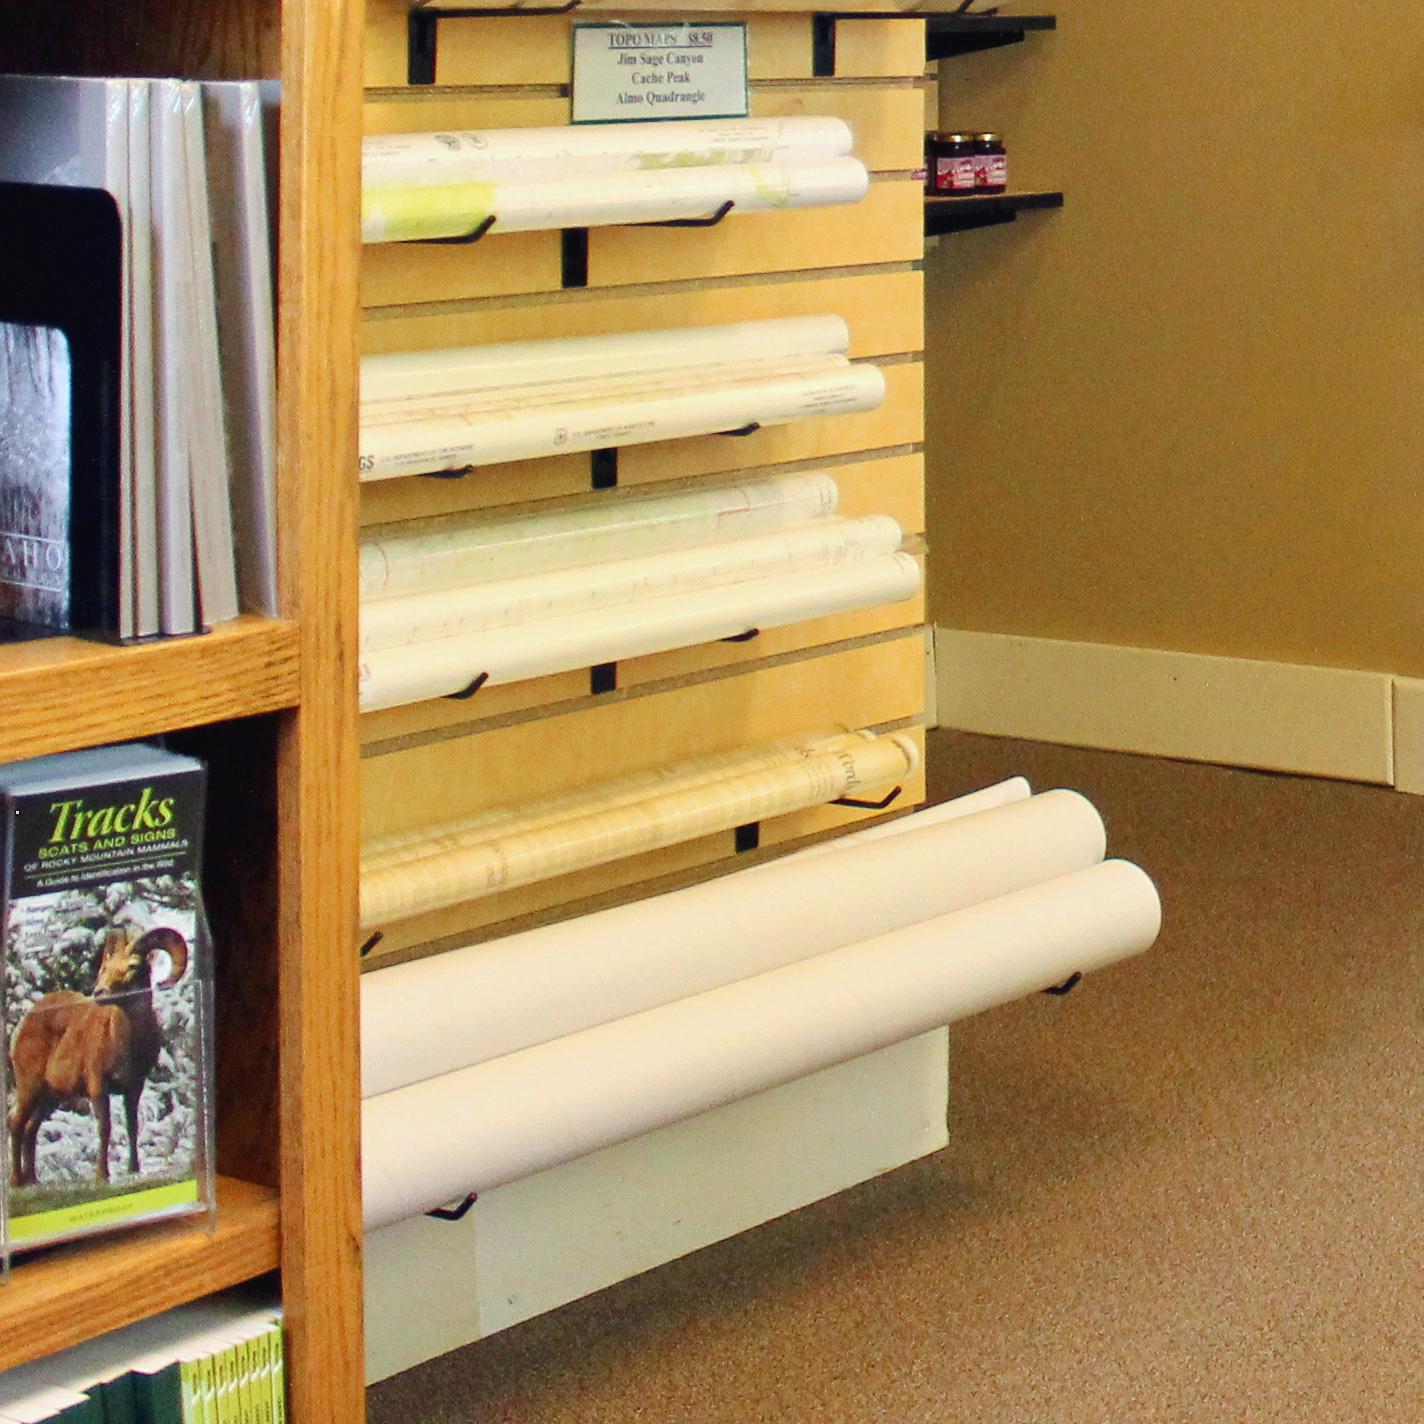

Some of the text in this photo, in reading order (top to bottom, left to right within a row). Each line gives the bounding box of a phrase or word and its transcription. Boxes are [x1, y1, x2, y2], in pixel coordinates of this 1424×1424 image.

[608, 33, 641, 46] TOPO
[645, 32, 678, 46] MAPS
[617, 53, 704, 66] Jim Sage Canyon
[631, 71, 691, 84] Cache Peak
[616, 91, 706, 106] Almo Quadrangle
[49, 786, 176, 843] Tracks
[38, 828, 176, 860] SCATS AND SIGNS
[24, 838, 189, 873] OF ROCKY MOUNTAIN MAMMALS
[36, 879, 44, 888] A
